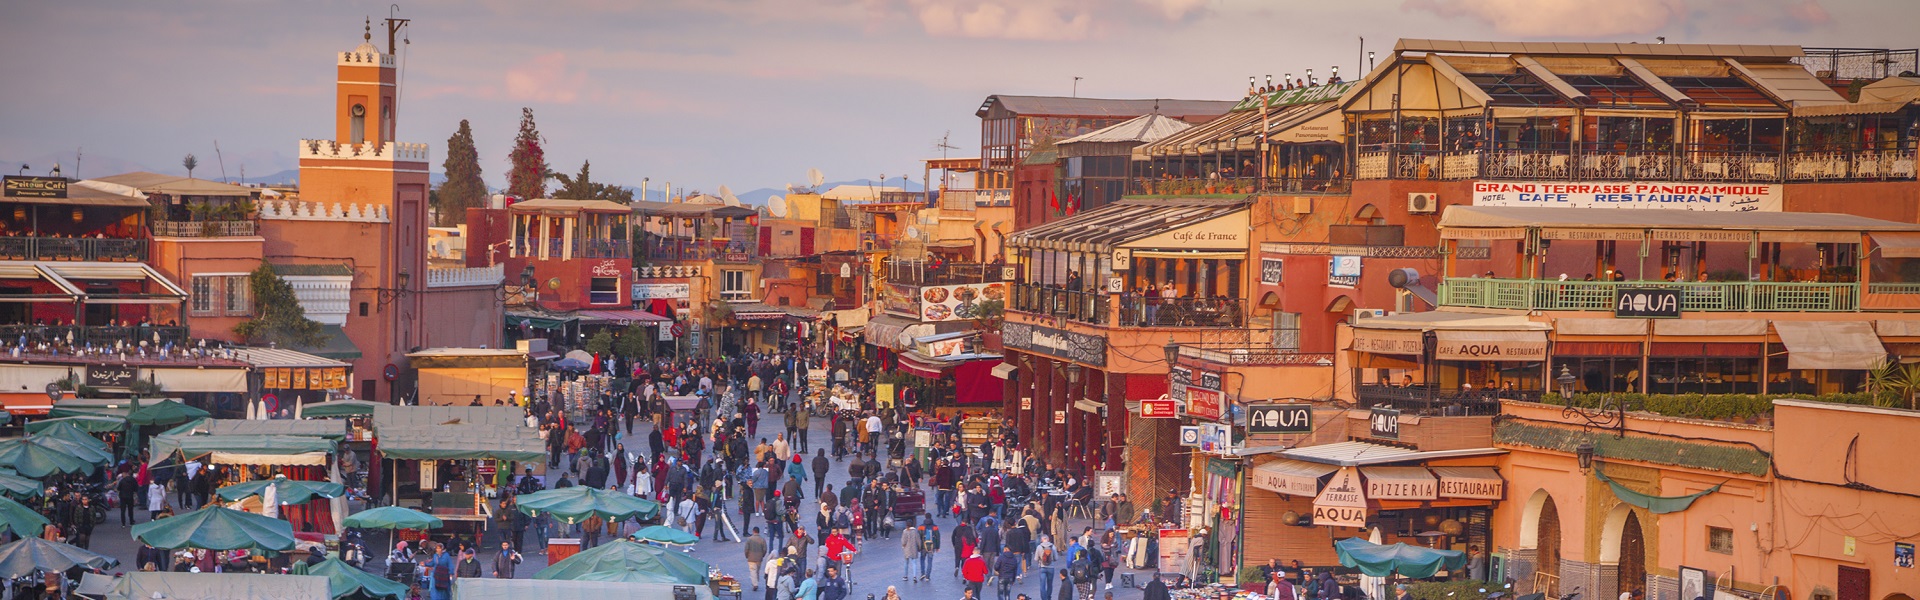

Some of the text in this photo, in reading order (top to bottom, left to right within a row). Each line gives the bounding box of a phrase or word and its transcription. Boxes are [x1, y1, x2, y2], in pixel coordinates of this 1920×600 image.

[1294, 132, 1330, 140] Panoramique
[6, 179, 66, 190] Zeitoun Café
[1475, 183, 1770, 196] GRAND TERRASSE PANORAMIQUE
[1482, 193, 1724, 203] HOTEL CAFE RESTAURANT
[1173, 231, 1238, 244] Café de France
[1544, 230, 1643, 240] CAFÉ RESTAURANT PIZZERIA
[1656, 231, 1750, 241] TERRASSE PANORAMIQUE
[1618, 293, 1677, 312] AQUA
[1439, 344, 1545, 357] CAFÉ AQUA RESTAURANT
[1251, 409, 1309, 427] AQUA
[1371, 413, 1398, 433] AQUA
[1268, 477, 1287, 489] AQUA
[1291, 481, 1316, 493] RESTAURANT
[1372, 483, 1432, 497] PIZZERIA
[1440, 481, 1502, 496] RESTAURANT
[1326, 493, 1359, 503] TERRASSE
[1314, 507, 1364, 522] AQUA
